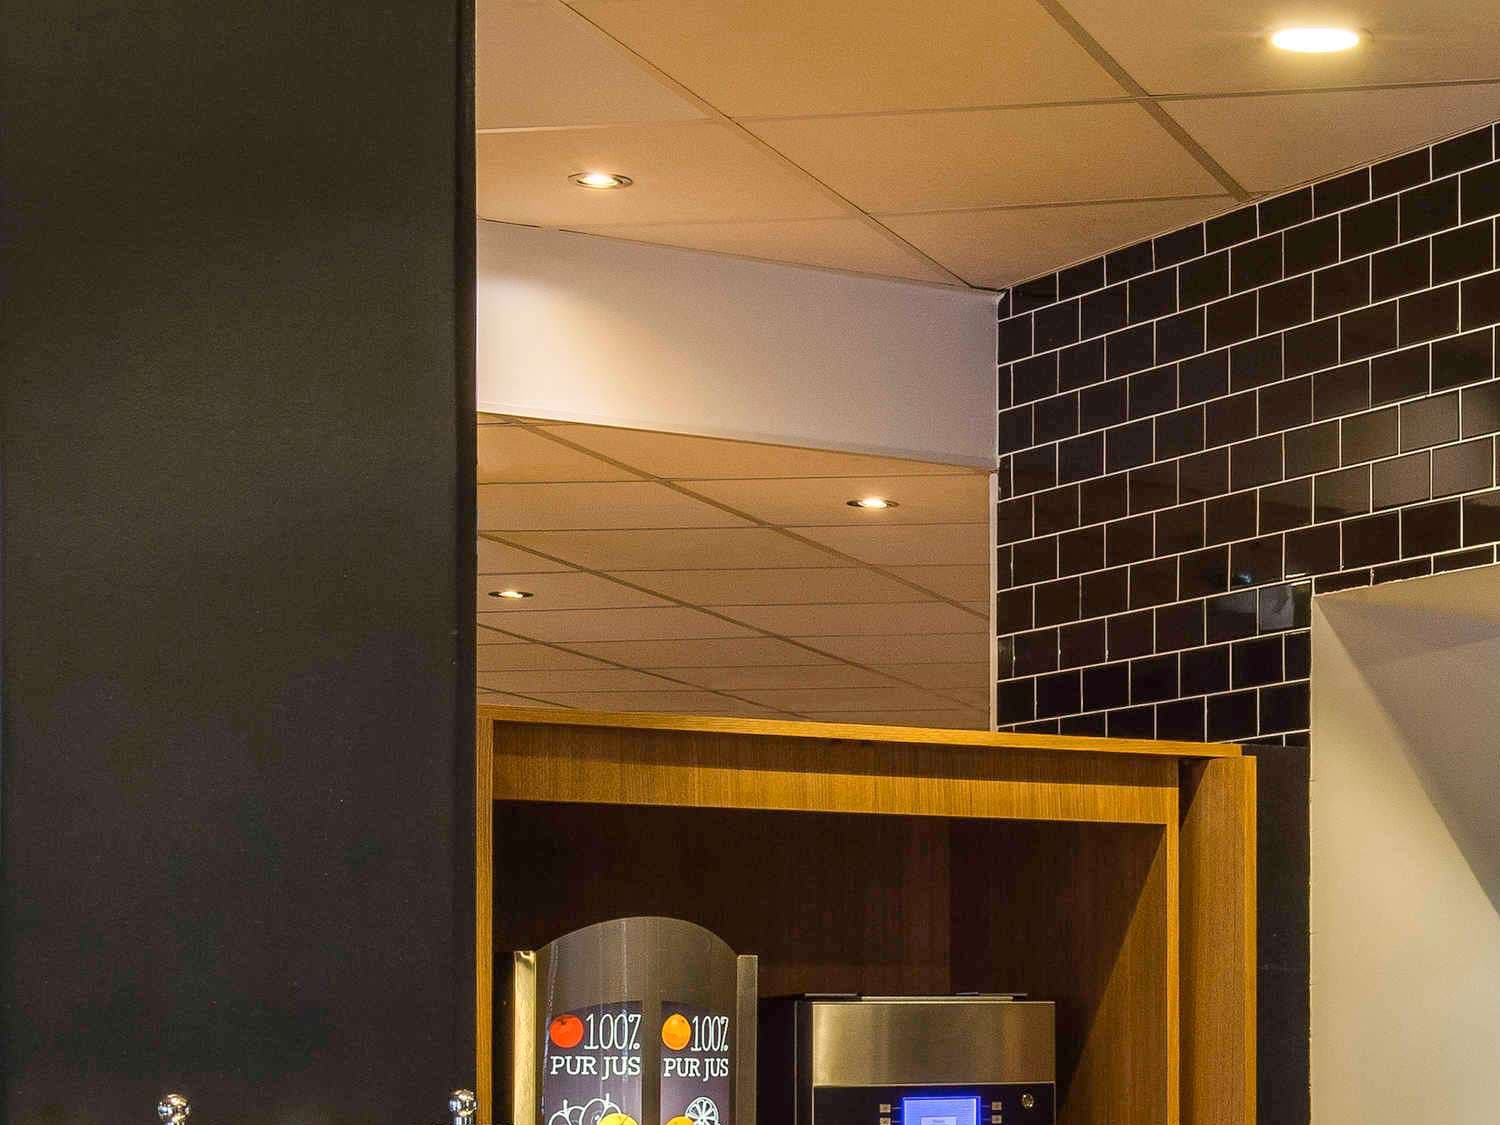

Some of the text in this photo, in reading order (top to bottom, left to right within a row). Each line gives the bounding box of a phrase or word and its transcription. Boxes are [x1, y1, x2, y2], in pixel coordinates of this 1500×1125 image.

[584, 1013, 641, 1050] 100%
[691, 1016, 729, 1051] 100%
[550, 1056, 641, 1080] PUR JUS
[664, 1058, 729, 1082] PUR JUS
